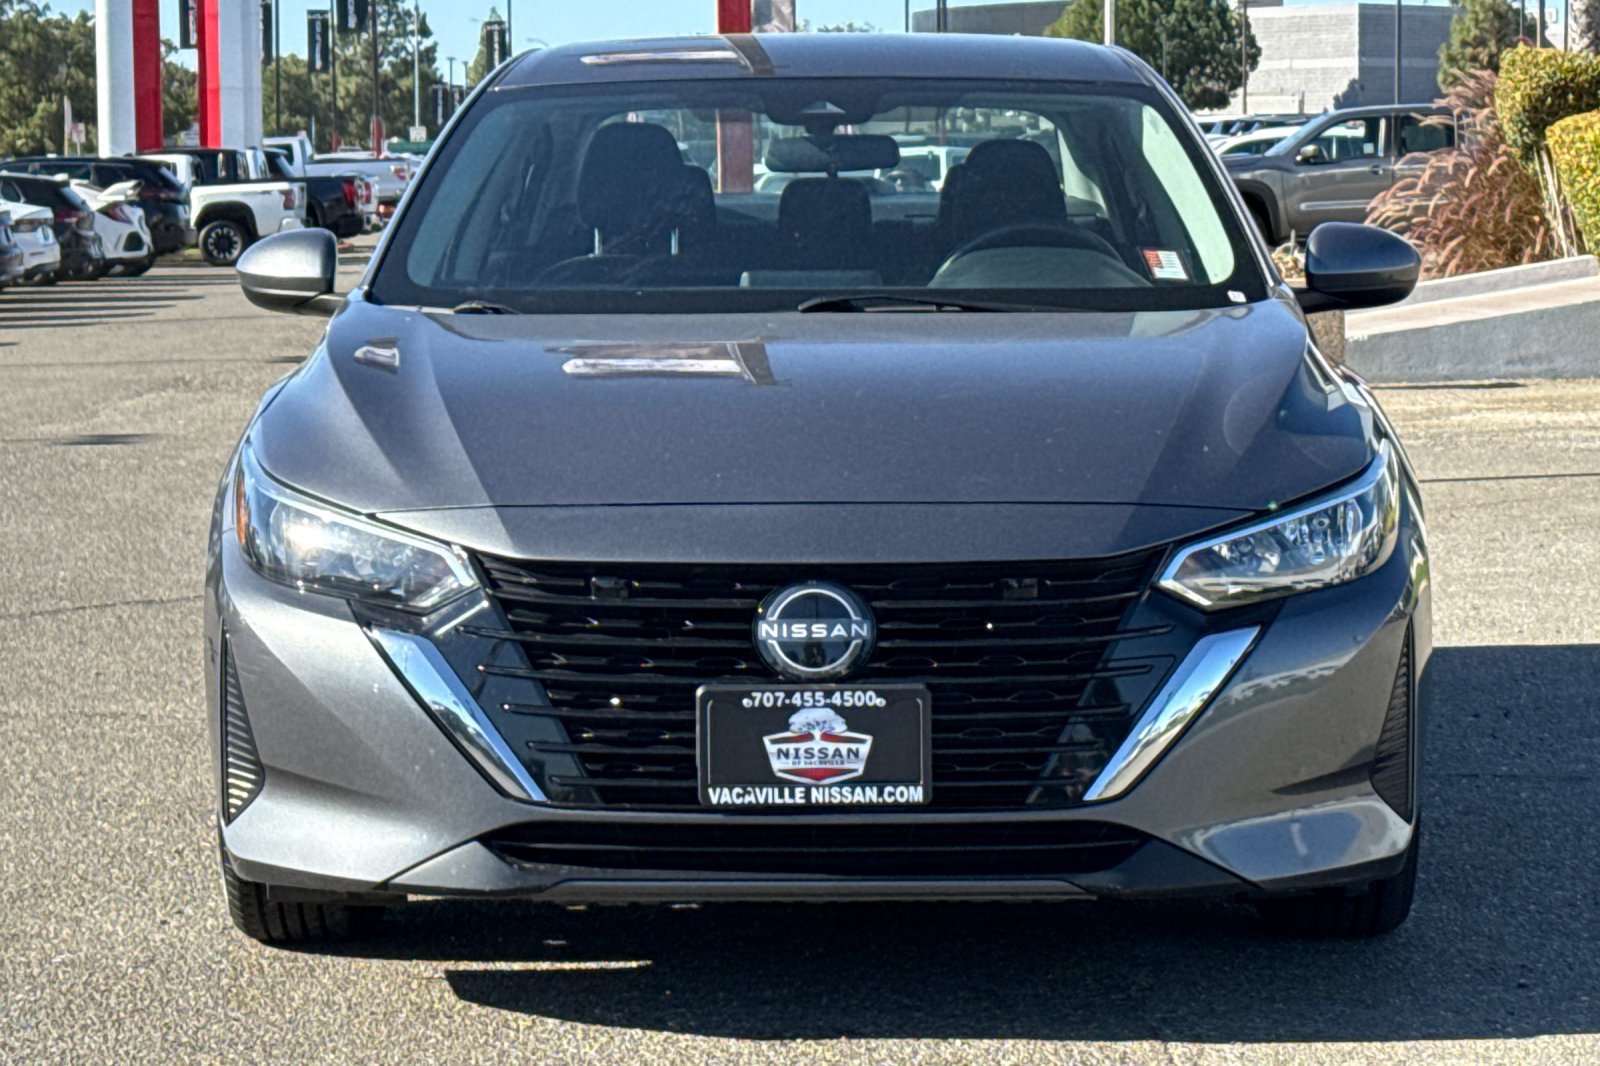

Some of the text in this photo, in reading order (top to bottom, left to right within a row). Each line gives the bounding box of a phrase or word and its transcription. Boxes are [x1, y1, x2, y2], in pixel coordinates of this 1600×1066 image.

[760, 623, 868, 638] NISSAN
[752, 691, 876, 707] 707-455-4500
[777, 747, 860, 760] NISSAN
[708, 786, 924, 804] VACAVILLE NISSAN.COM
